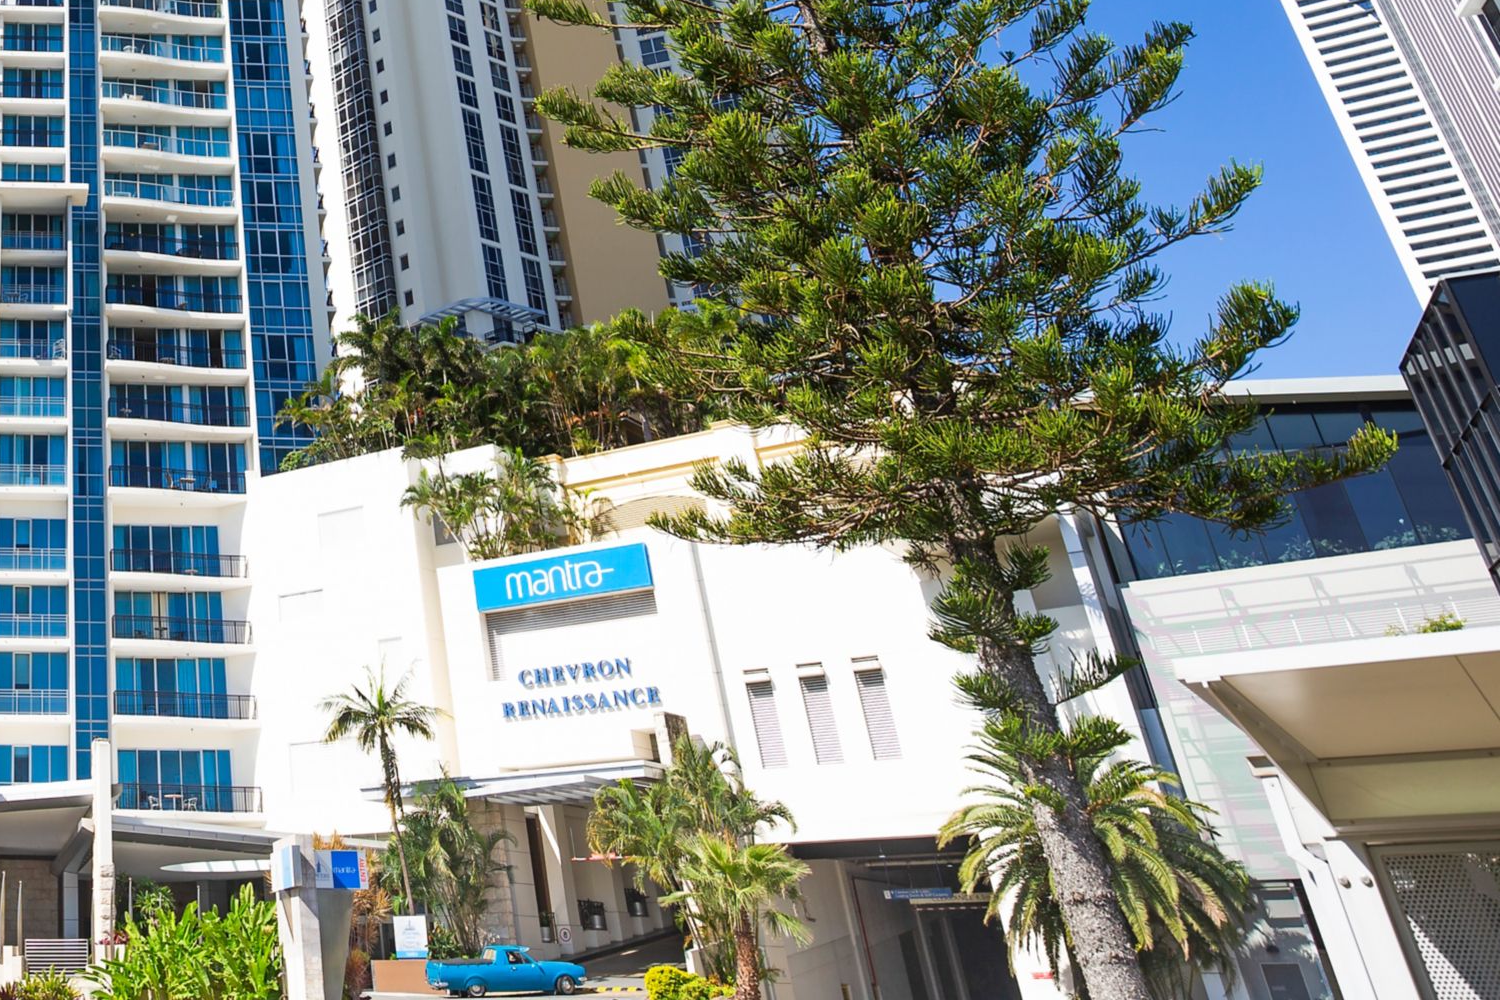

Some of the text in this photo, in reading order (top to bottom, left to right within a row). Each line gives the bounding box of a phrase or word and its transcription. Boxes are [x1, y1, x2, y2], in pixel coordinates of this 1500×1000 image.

[505, 560, 614, 600] mantra
[518, 657, 632, 688] CHEVRON
[502, 686, 662, 720] RENAISSANCE
